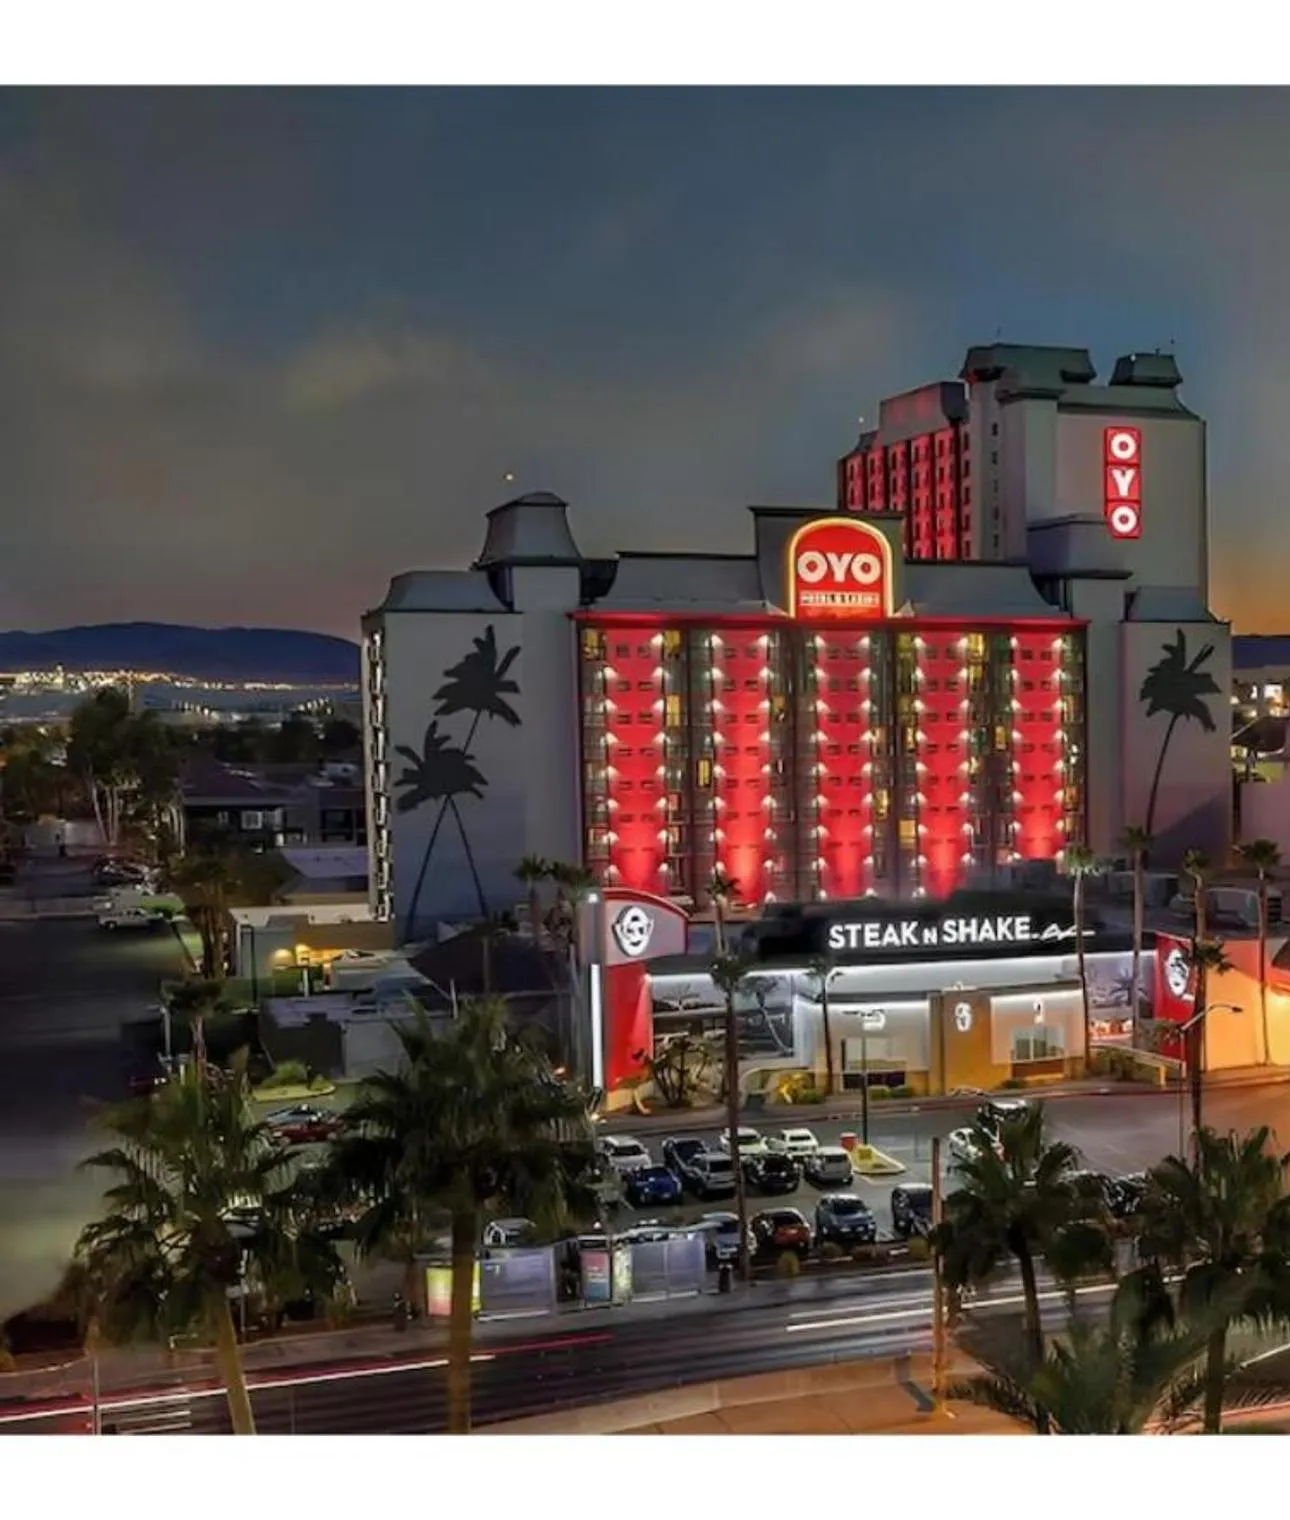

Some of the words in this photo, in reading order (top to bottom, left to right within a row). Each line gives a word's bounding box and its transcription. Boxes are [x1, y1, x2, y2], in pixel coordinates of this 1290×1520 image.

[797, 550, 881, 585] OYO
[828, 921, 918, 950] STEAK
[922, 927, 938, 945] N
[941, 916, 1031, 943] SHAKE
